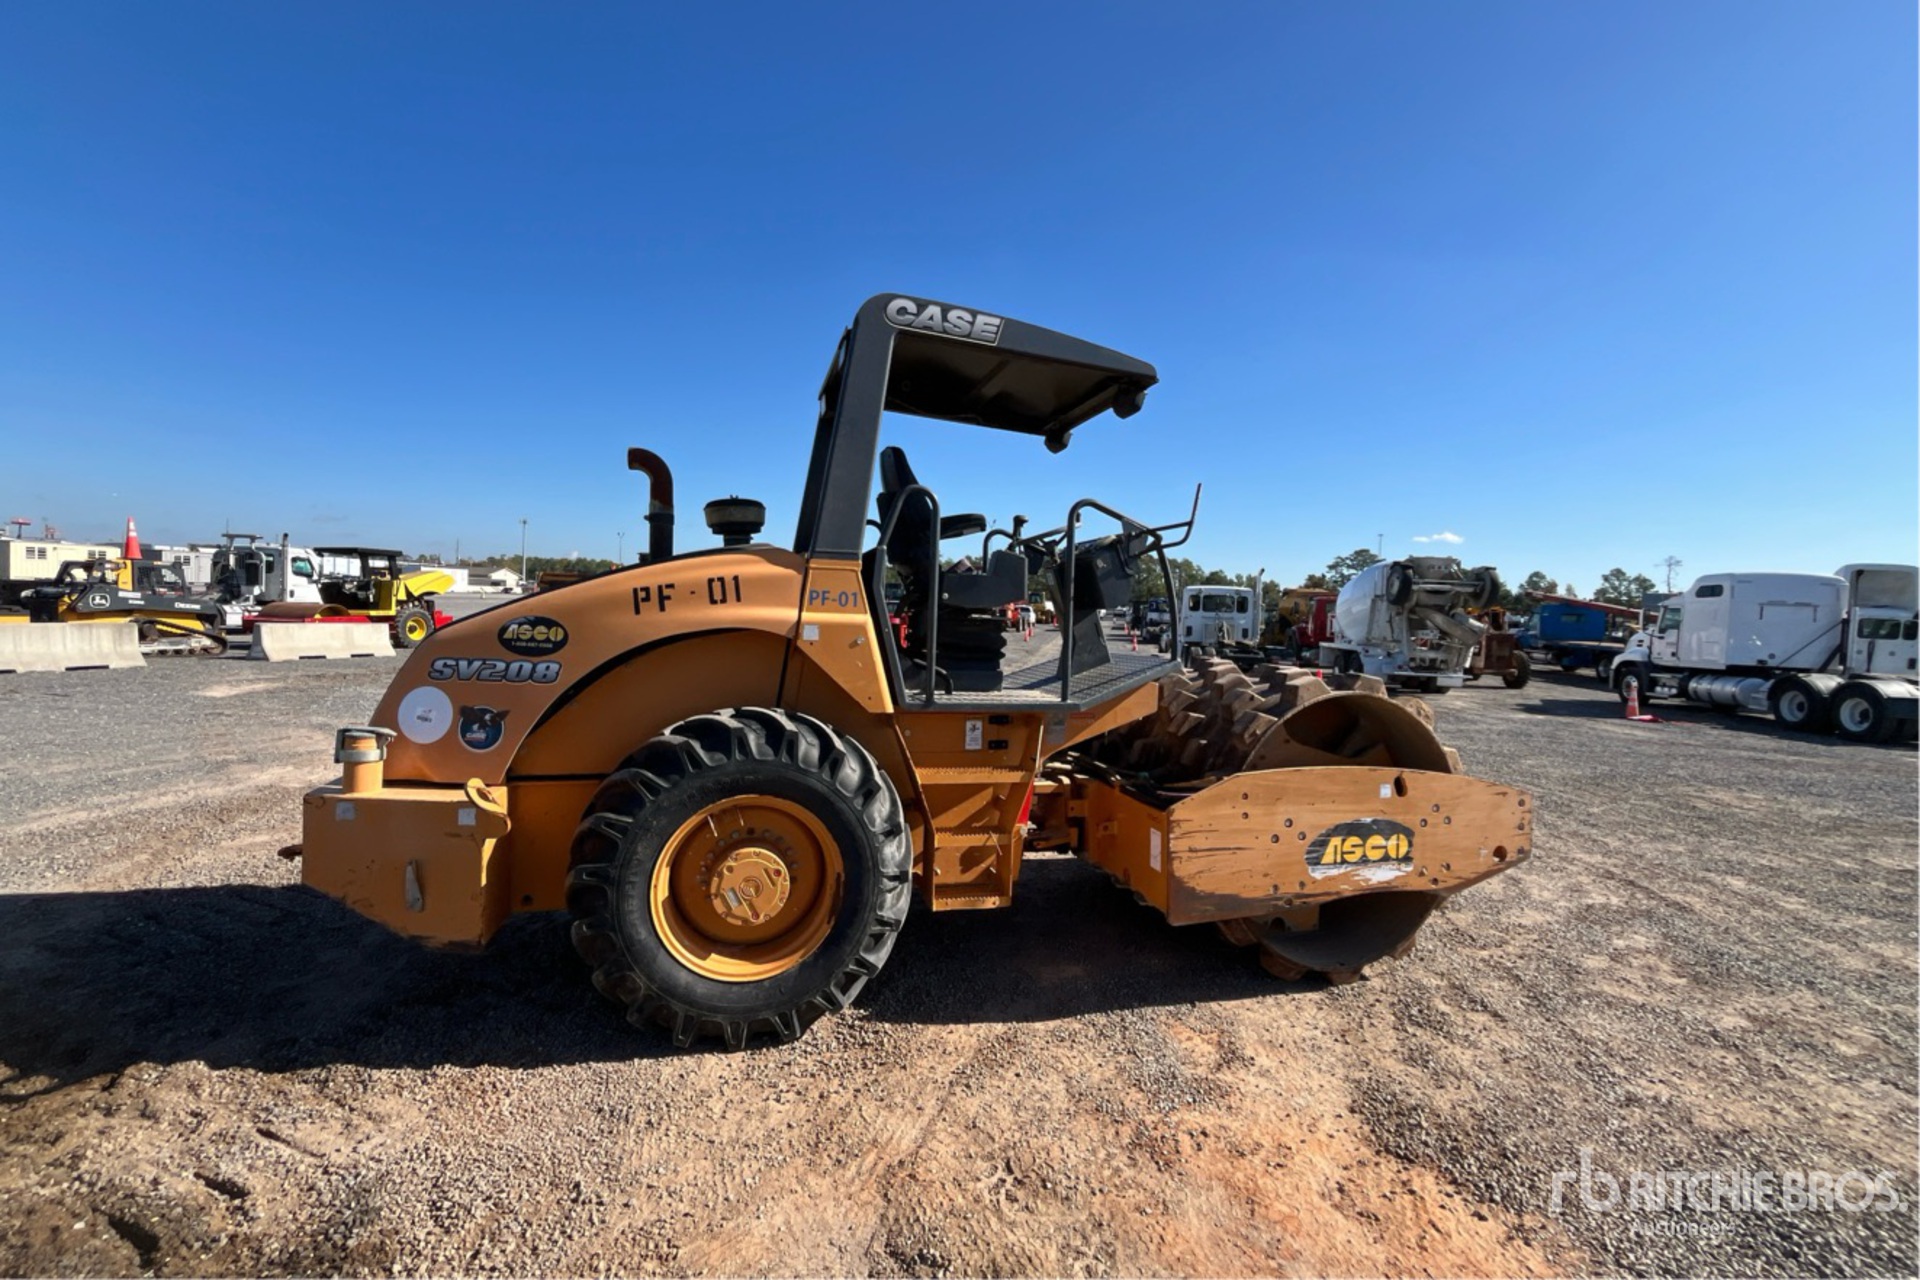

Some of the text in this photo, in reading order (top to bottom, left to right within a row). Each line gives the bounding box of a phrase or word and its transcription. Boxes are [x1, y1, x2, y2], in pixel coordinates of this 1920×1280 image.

[886, 298, 1000, 342] CASE
[632, 583, 676, 616] PF
[707, 575, 742, 605] 01
[808, 589, 859, 608] PF-01
[503, 623, 565, 643] ASCO
[428, 657, 562, 683] SV208
[1320, 833, 1409, 865] ASCO
